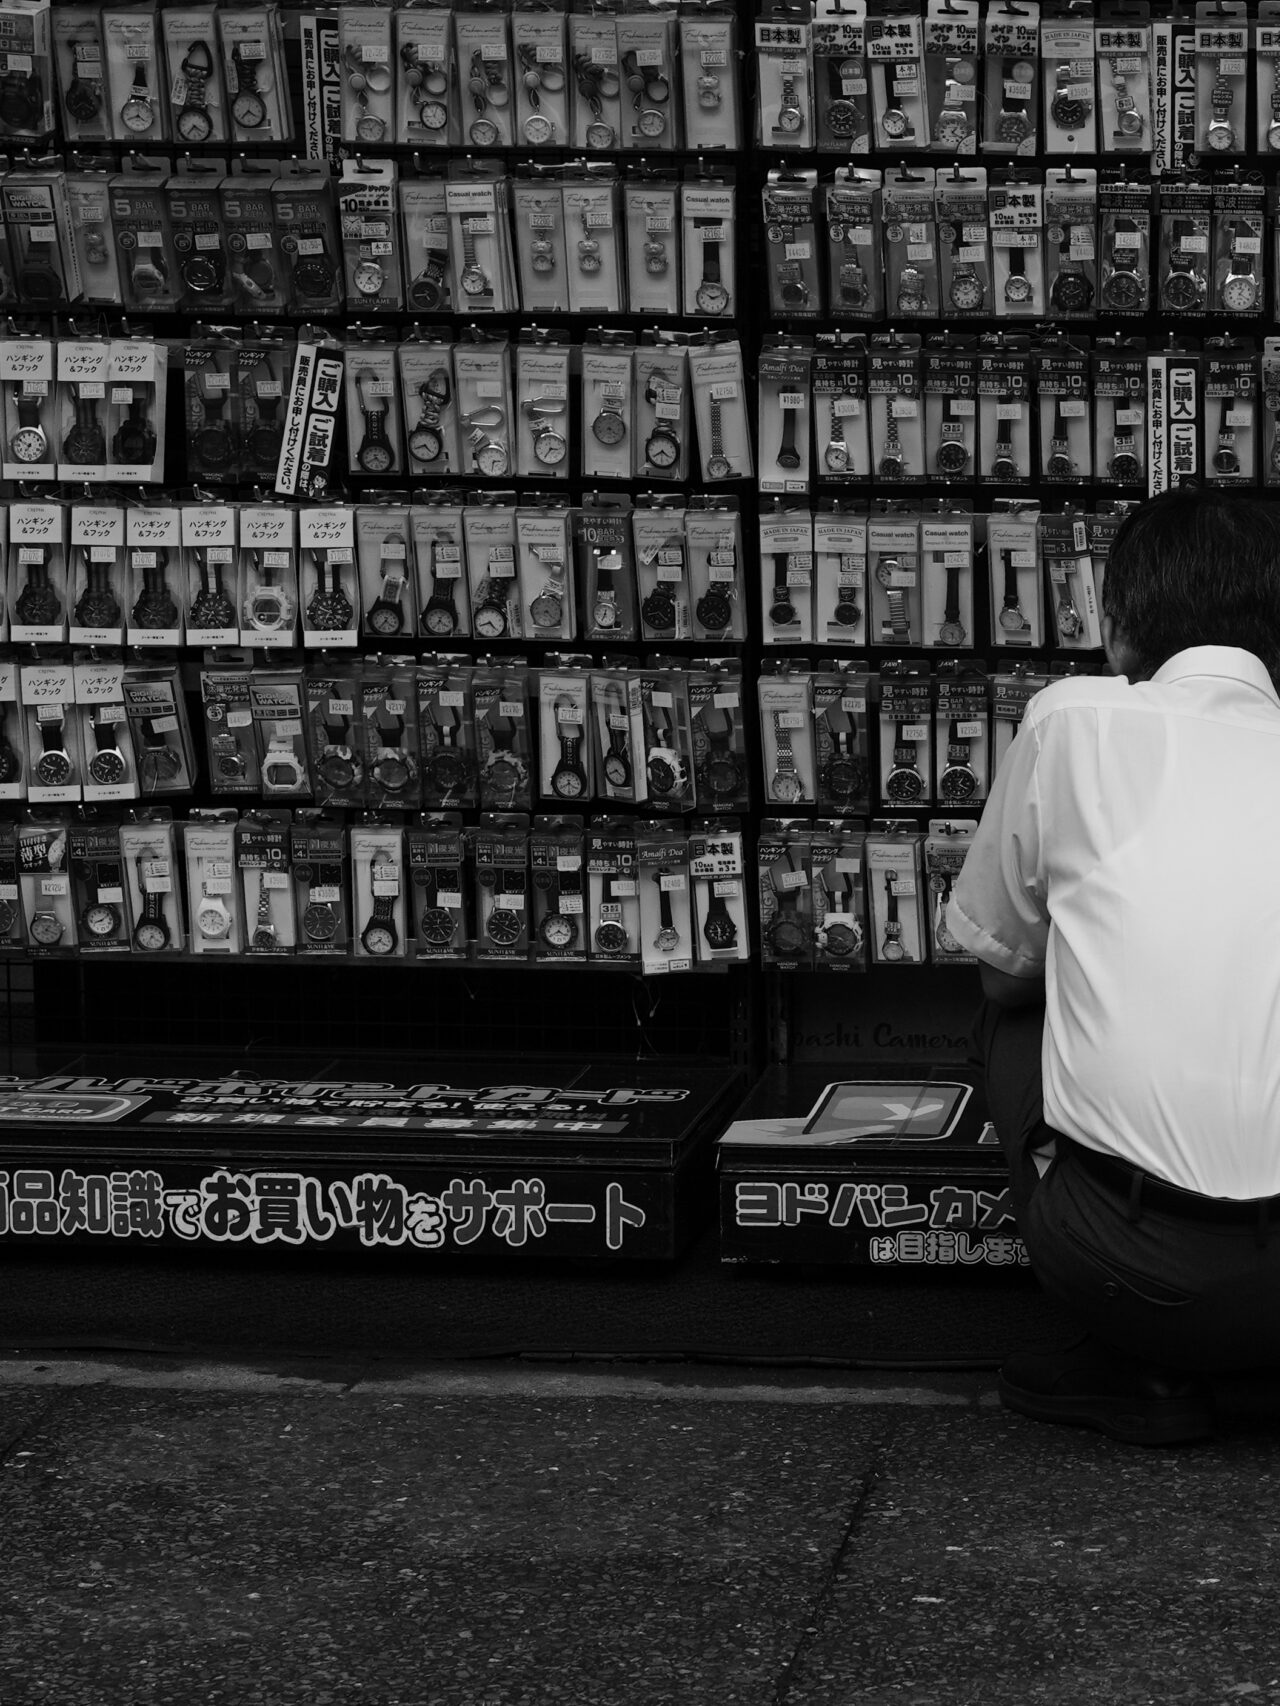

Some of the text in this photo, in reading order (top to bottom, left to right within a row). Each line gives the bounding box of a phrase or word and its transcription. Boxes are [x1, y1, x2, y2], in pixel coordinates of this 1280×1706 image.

[760, 29, 800, 43] 日本製
[871, 25, 911, 37] 日本製
[1100, 33, 1141, 47] 日本製
[1200, 33, 1243, 47] 日本製
[994, 195, 1036, 207] 日本製
[170, 201, 187, 217] 5
[276, 204, 293, 220] 5
[6, 354, 44, 362] ハンギング
[762, 362, 787, 373] Amalfi
[17, 517, 55, 525] ハンギング
[78, 520, 117, 528] ハンギング
[189, 520, 227, 528] ハンギング
[308, 521, 346, 530] ハンギング
[28, 678, 66, 687] ハンギング
[642, 848, 666, 859] Amalfi
[695, 843, 734, 856] 日本製
[873, 1022, 968, 1048] Camera
[0, 1076, 690, 1105] ールドポイントカード
[0, 1170, 646, 1250] 品知識でお買い物をサポート
